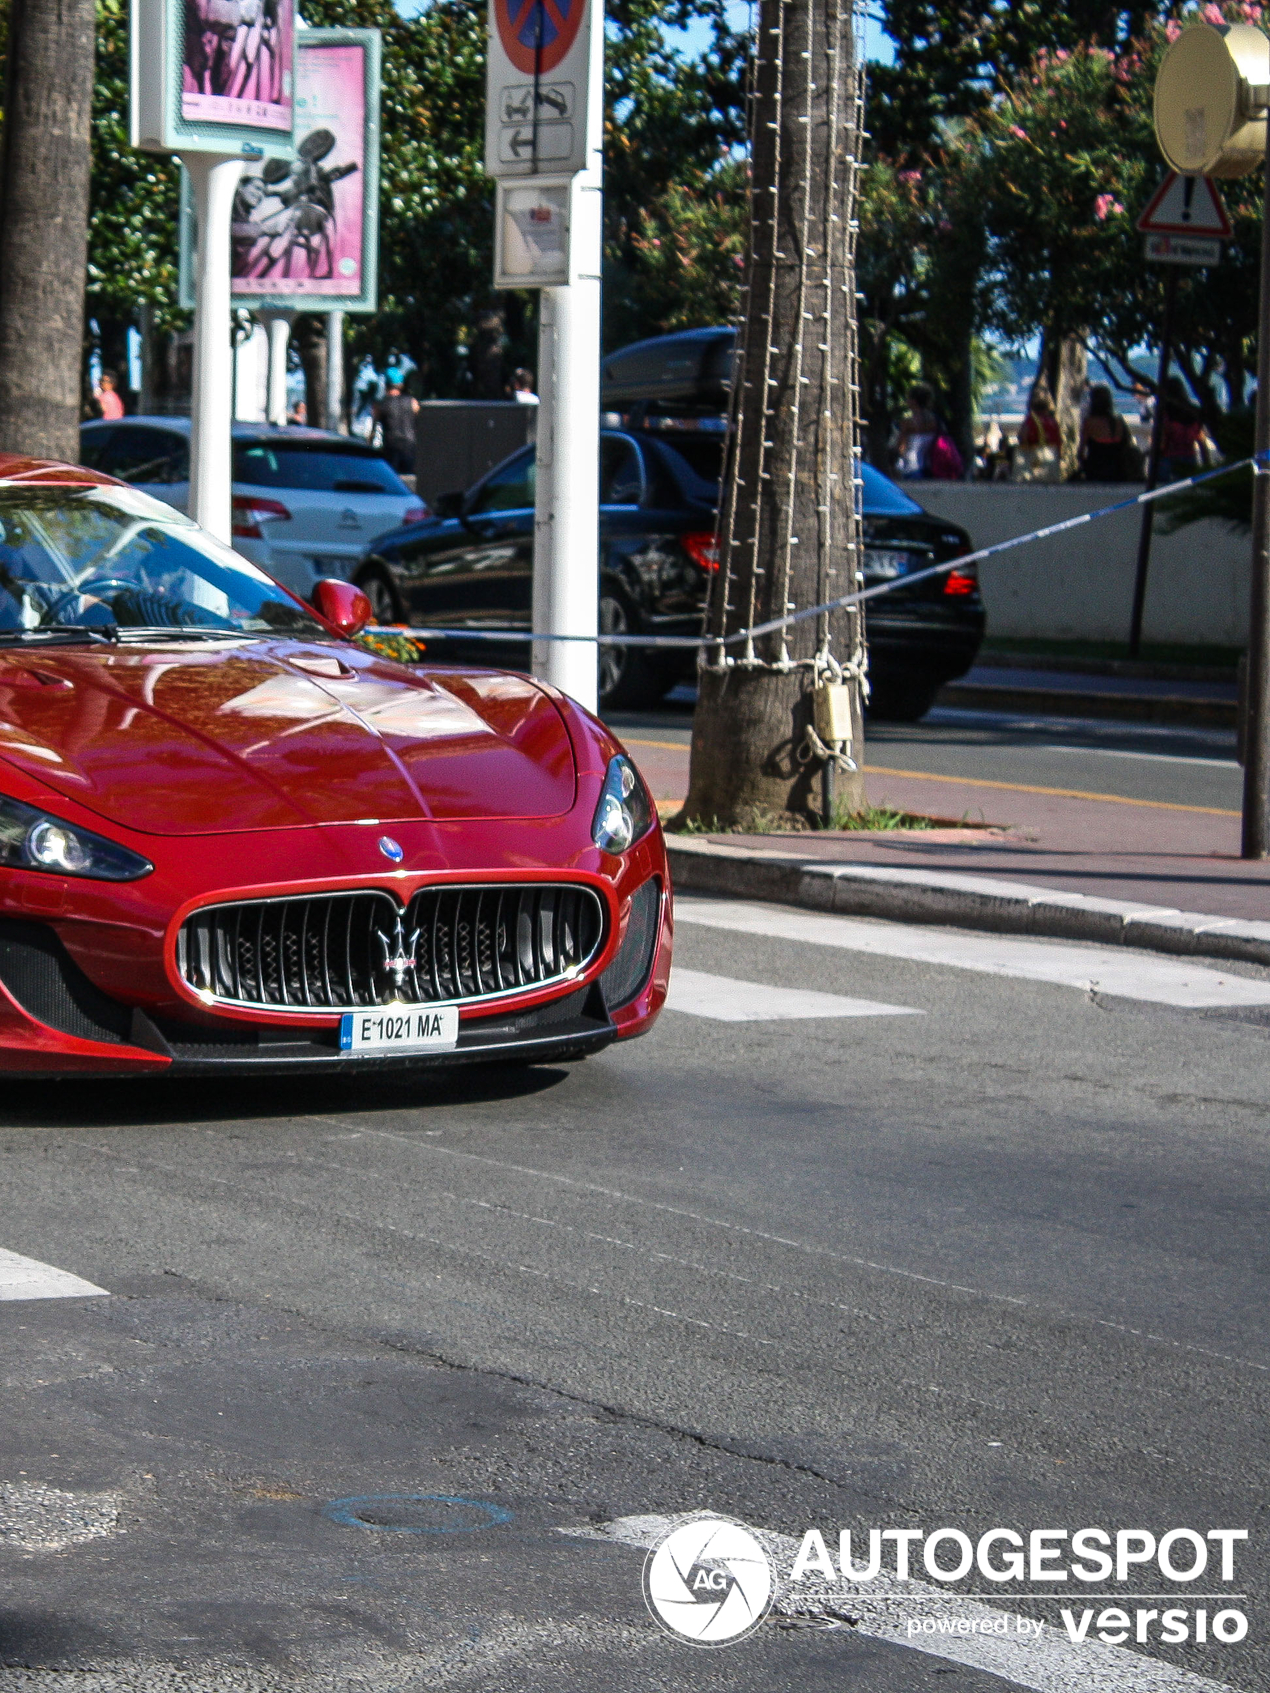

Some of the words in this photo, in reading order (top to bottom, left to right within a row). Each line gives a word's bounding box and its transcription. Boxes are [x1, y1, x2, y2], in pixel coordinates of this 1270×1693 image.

[361, 1019, 371, 1041] E
[377, 1015, 411, 1040] 1021
[417, 1013, 442, 1037] MA
